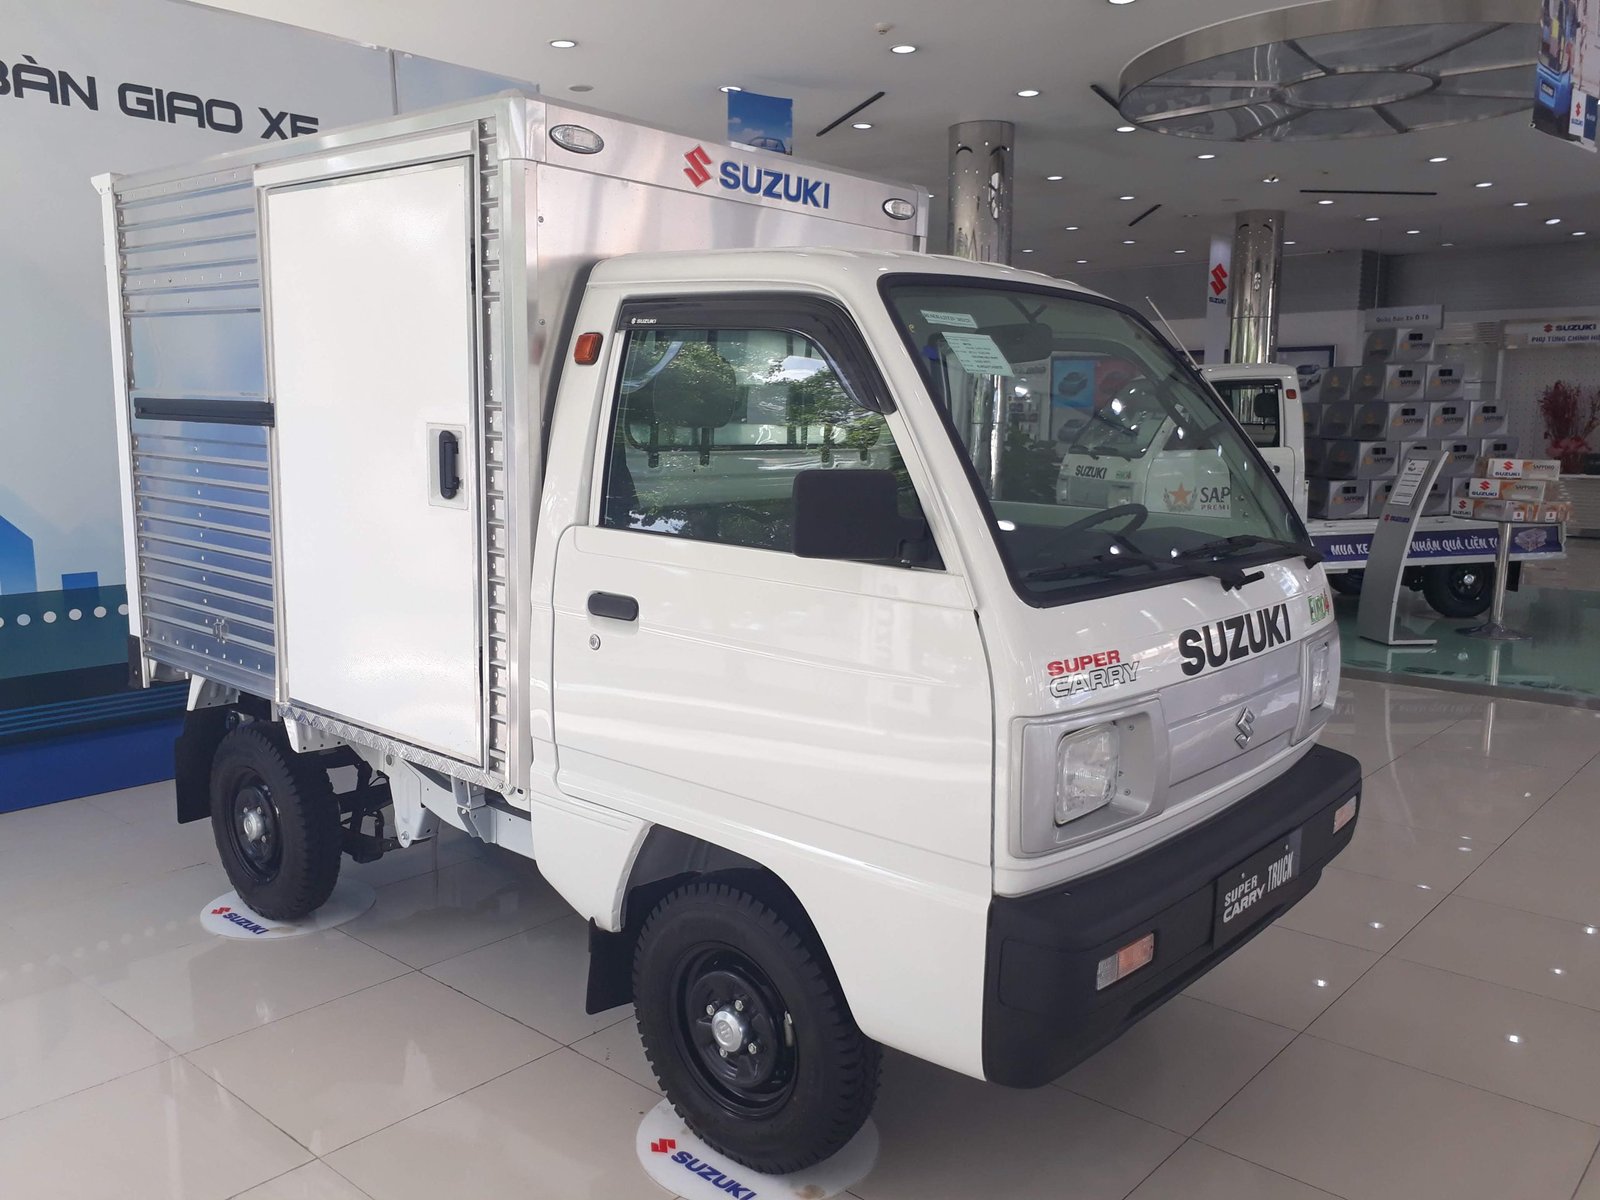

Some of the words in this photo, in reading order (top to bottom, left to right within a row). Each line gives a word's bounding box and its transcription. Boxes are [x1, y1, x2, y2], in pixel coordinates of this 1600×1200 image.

[0, 54, 99, 111] ÀN
[118, 82, 243, 134] GIAO
[719, 161, 830, 209] SUZUKI
[1555, 323, 1597, 331] SUZUKI
[1075, 465, 1107, 480] SUZUKI
[1331, 544, 1355, 555] MUA
[1356, 543, 1369, 554] XE
[1411, 538, 1441, 554] NHẬN
[1178, 604, 1291, 676] SUZUKI
[1047, 650, 1120, 676] SUPER
[1050, 661, 1139, 698] CARRY
[1224, 874, 1258, 907] SUPER
[1268, 851, 1294, 893] TRUCK
[1223, 882, 1266, 923] CARRY
[223, 912, 269, 935] SUZUKI
[671, 1150, 757, 1200] SUZUKI
